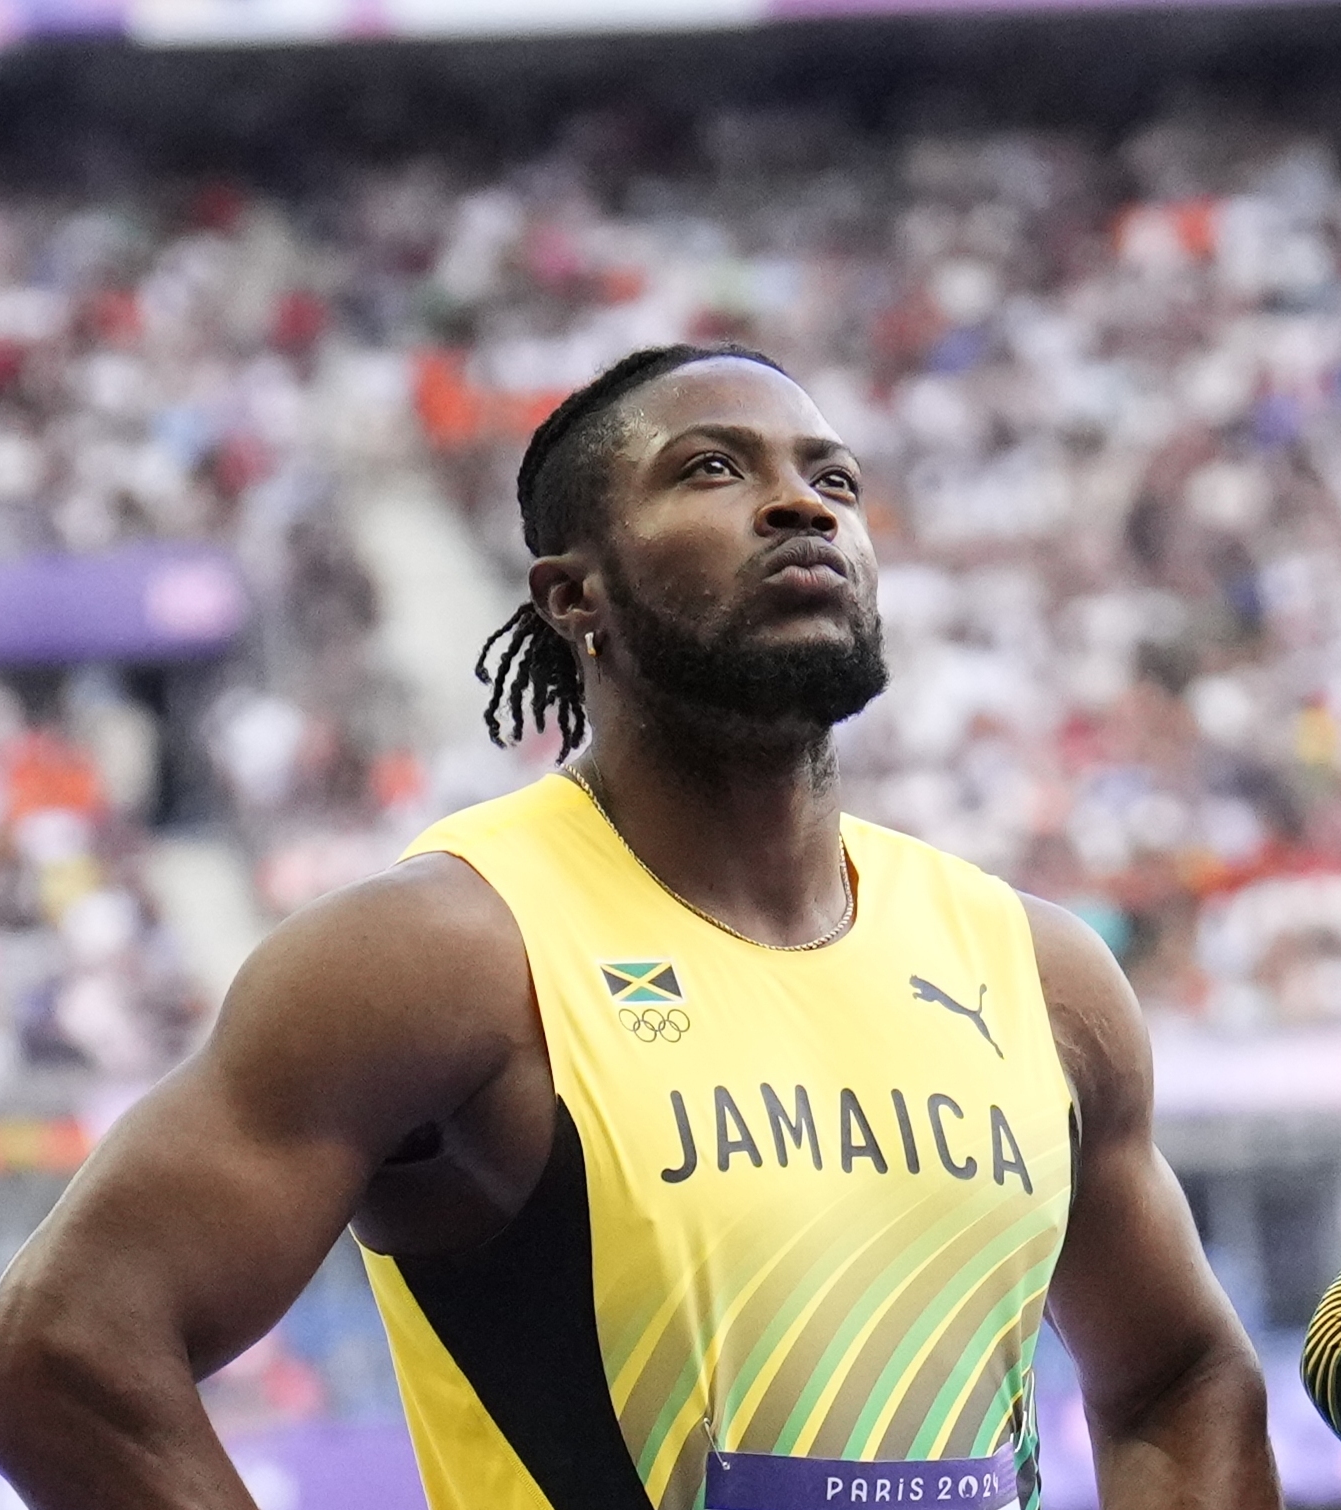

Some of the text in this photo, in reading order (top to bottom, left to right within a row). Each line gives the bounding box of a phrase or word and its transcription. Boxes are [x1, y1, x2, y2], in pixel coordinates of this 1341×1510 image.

[661, 1082, 1033, 1197] JAMAICA
[826, 1471, 999, 1502] PARIS 2024
